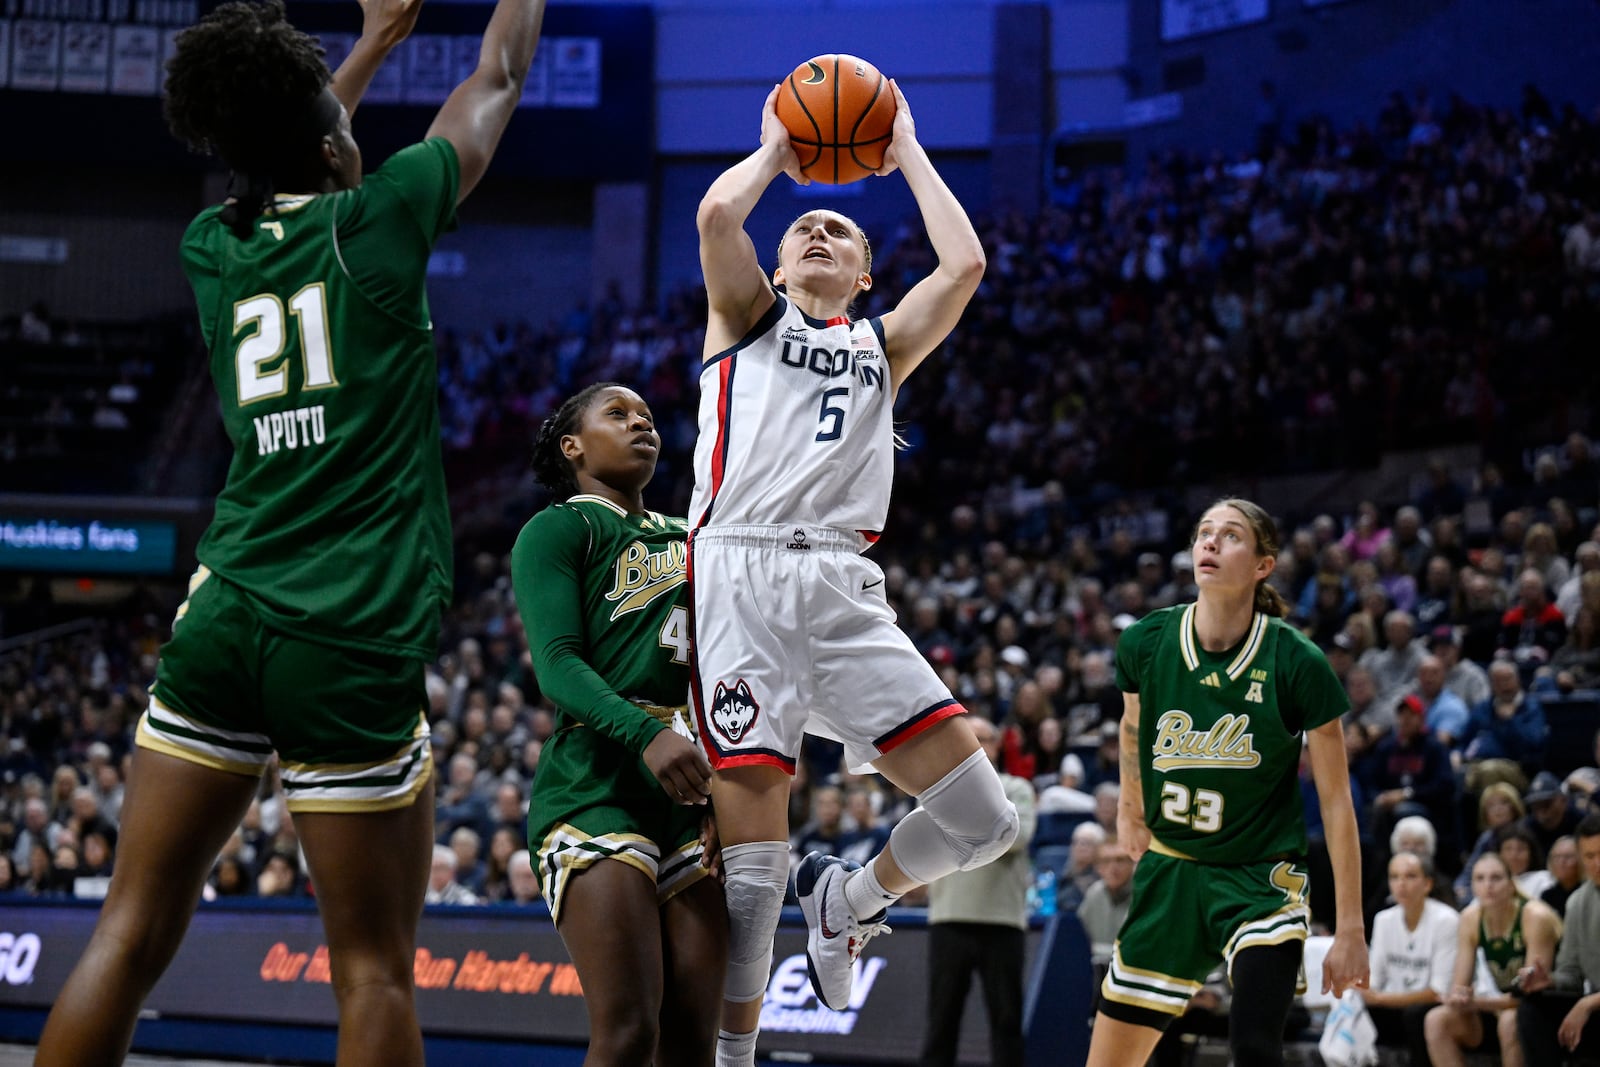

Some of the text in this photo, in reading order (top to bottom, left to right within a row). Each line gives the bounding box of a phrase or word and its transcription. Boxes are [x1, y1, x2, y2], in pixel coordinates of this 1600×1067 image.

[232, 281, 340, 407] 21
[253, 405, 326, 456] MPUTU
[815, 387, 849, 442] 5
[88, 519, 138, 552] fans
[786, 542, 811, 551] UCONN
[658, 604, 692, 666] 4
[1244, 681, 1263, 704] A
[1152, 709, 1262, 772] Bulls
[1161, 780, 1225, 833] 23
[260, 941, 308, 982] Our
[453, 949, 553, 994] Harder
